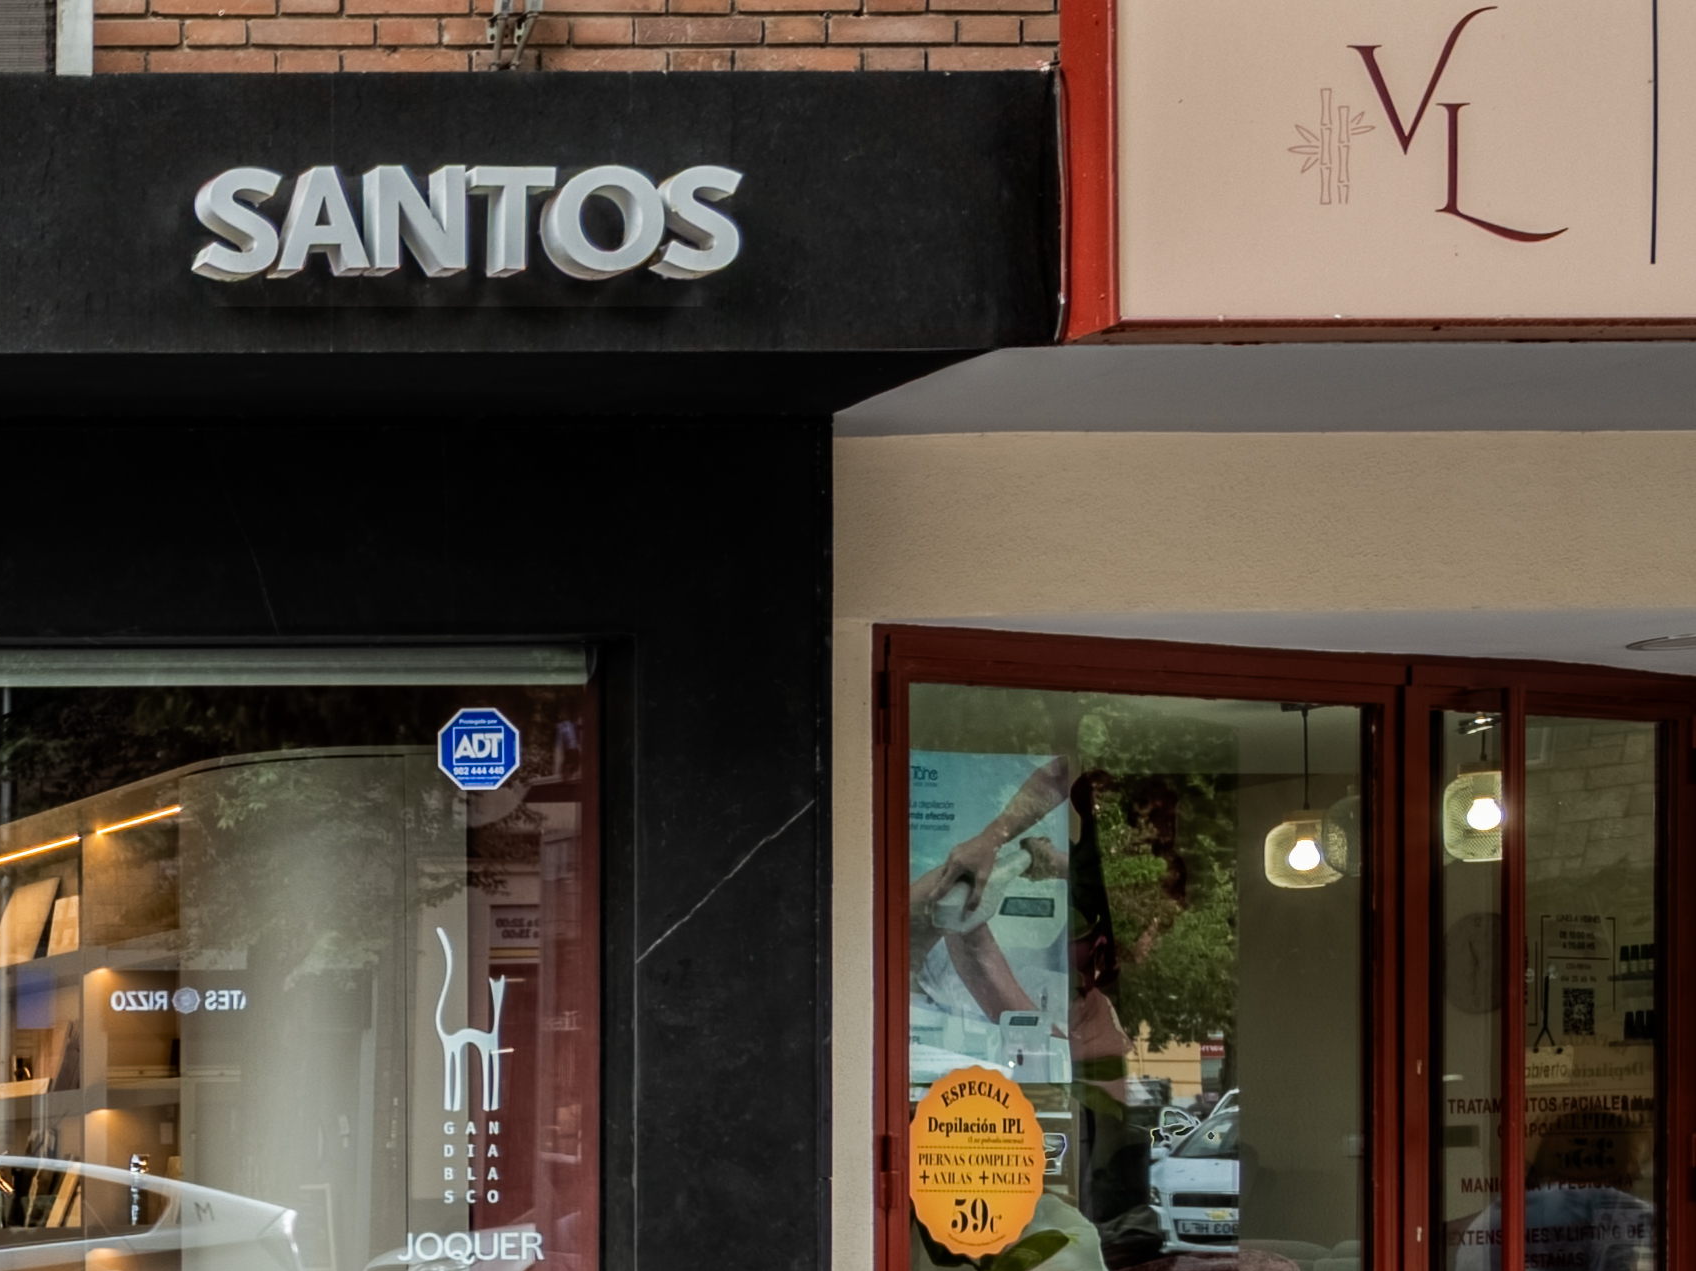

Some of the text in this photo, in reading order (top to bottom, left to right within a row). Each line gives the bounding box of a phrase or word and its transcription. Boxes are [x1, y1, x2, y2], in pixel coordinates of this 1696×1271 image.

[191, 164, 744, 283] SANTOS
[454, 733, 503, 759] ADT
[941, 1081, 1011, 1110] ESPECIAL
[927, 1116, 1025, 1137] Depilación IPL
[918, 1153, 1034, 1167] PIERNAS COMPLETAS
[397, 1231, 545, 1265] JOQUER
